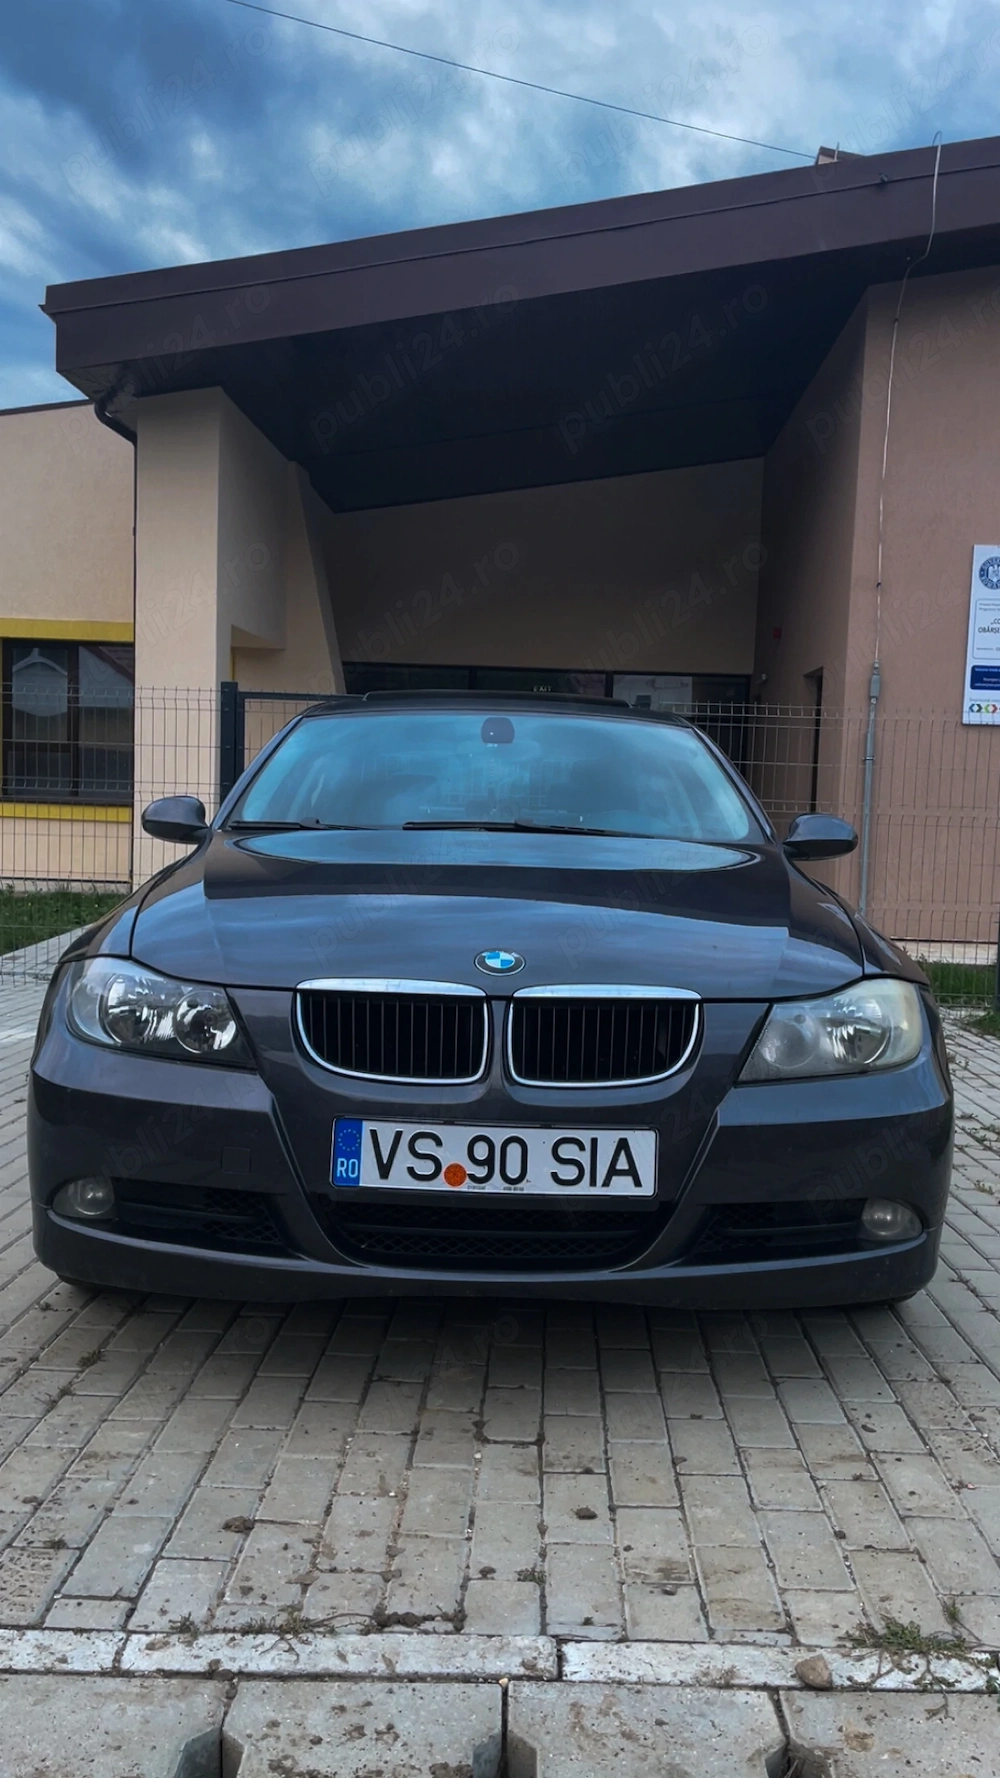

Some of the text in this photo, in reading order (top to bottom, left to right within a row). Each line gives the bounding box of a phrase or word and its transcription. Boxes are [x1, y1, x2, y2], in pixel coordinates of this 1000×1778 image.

[337, 1157, 358, 1178] RO
[369, 1128, 643, 1188] VS 90 SIA
